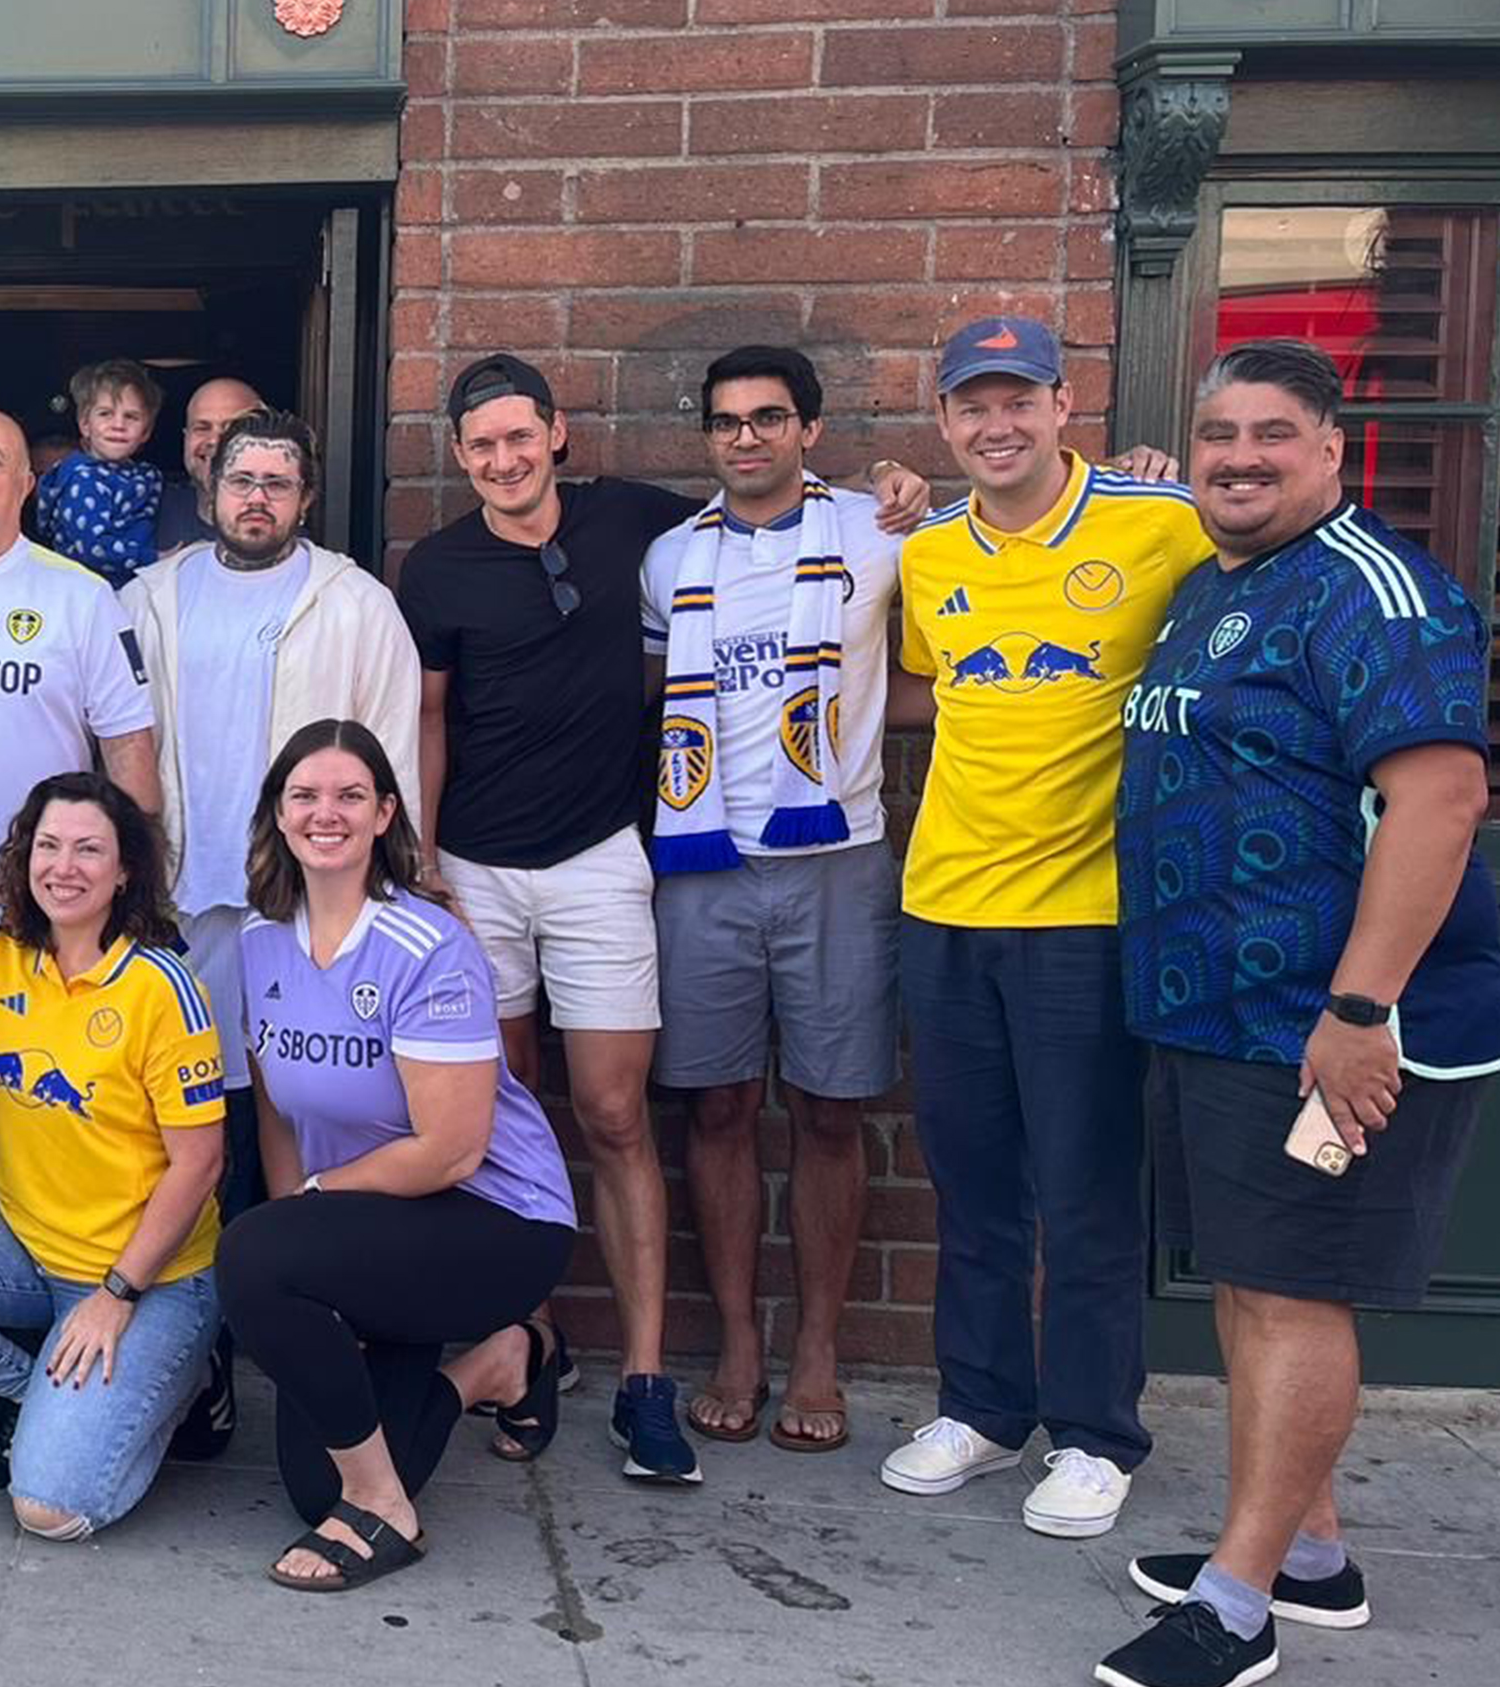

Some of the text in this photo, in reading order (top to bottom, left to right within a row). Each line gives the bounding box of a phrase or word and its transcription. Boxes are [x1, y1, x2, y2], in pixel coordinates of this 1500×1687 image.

[714, 632, 787, 666] veni
[738, 664, 785, 691] Po
[1124, 684, 1202, 735] BOXT
[278, 1028, 384, 1069] SBOTOP
[177, 1056, 220, 1083] BOX
